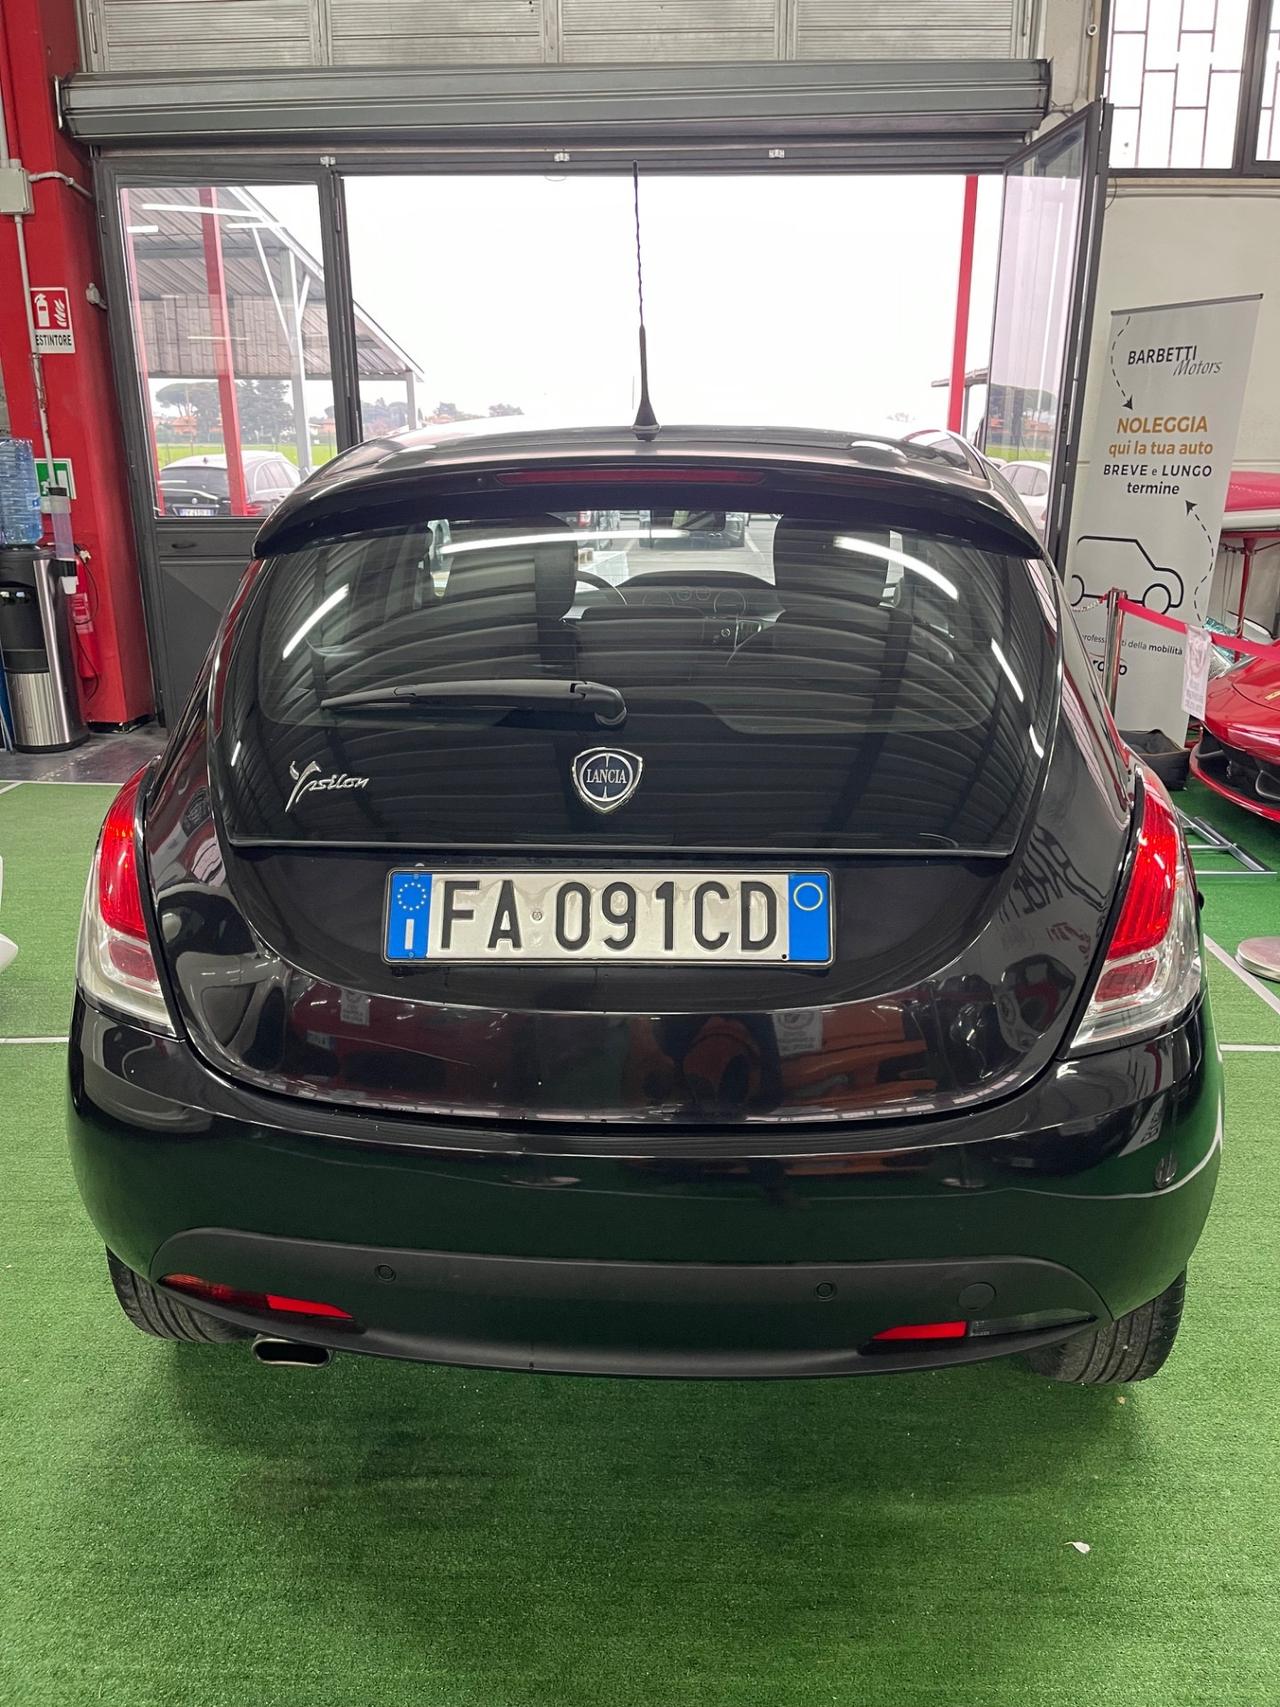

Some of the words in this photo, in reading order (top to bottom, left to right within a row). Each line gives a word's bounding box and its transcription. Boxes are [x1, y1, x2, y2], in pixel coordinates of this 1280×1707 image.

[35, 334, 72, 346] ESTINTORE
[1128, 345, 1197, 365] BARBETTI
[1173, 359, 1222, 376] Motors
[1117, 416, 1208, 434] NOLEGGIA
[1108, 440, 1131, 457] qui
[1134, 441, 1147, 454] la
[1150, 442, 1175, 455] tua
[1179, 441, 1213, 455] auto
[1103, 465, 1148, 476] BREVE
[1152, 468, 1158, 476] e
[1162, 465, 1212, 477] LUNGO
[1127, 480, 1180, 495] termine
[1128, 641, 1147, 650] della
[1148, 645, 1183, 656] mobilità
[586, 768, 628, 784] LANCIA
[285, 760, 370, 812] Ypsilon
